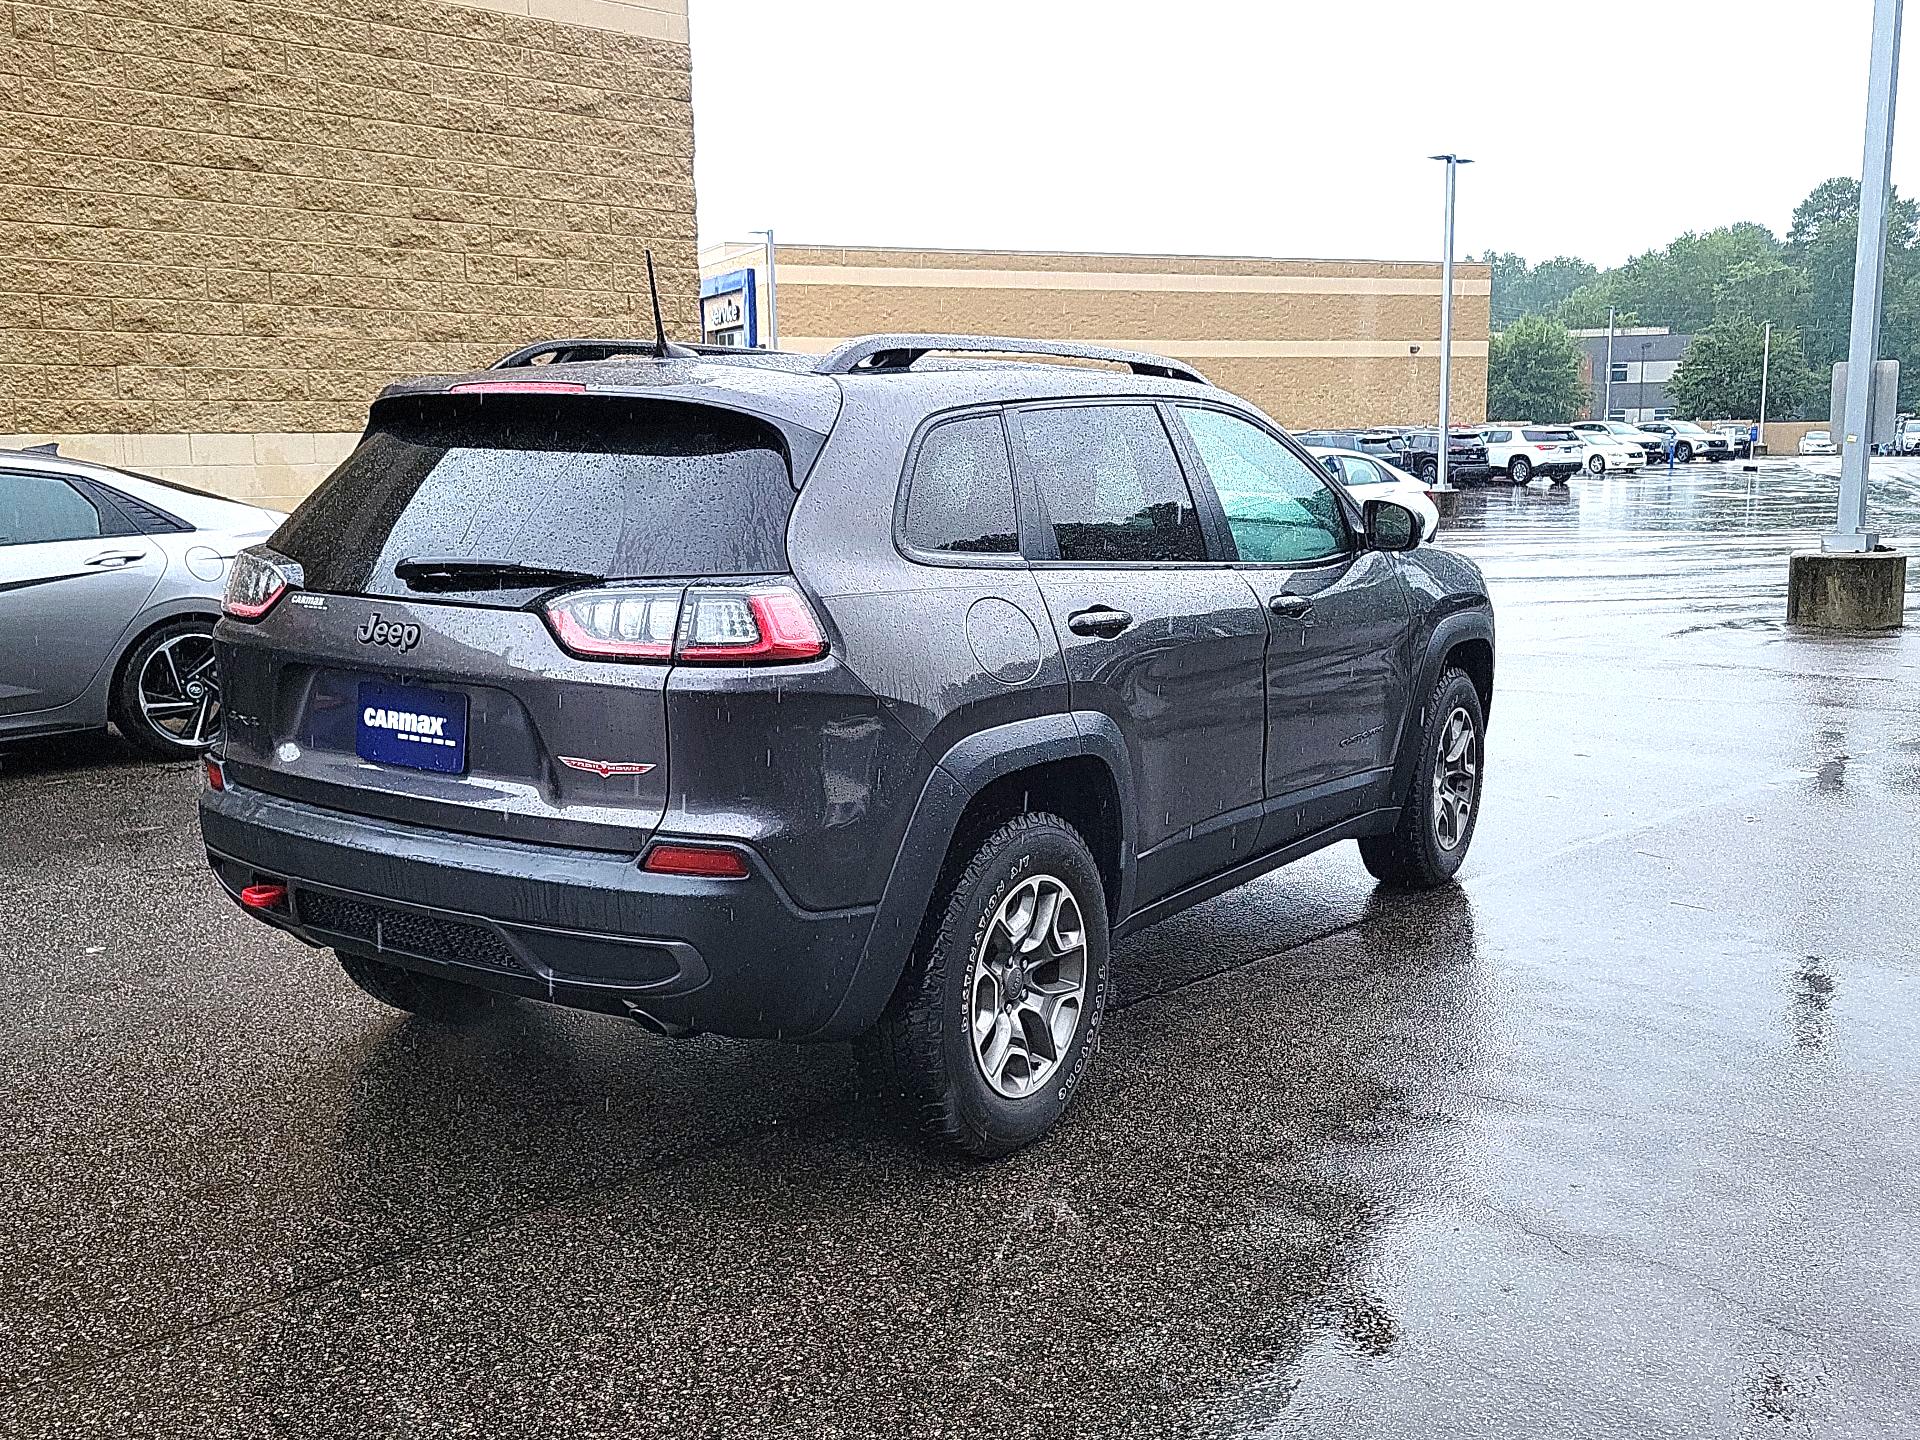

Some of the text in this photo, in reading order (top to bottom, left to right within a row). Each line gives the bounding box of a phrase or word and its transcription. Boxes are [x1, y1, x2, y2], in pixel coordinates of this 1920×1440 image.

[357, 612, 421, 654] Jeep
[961, 854, 1030, 1033] DESTINATION A/T
